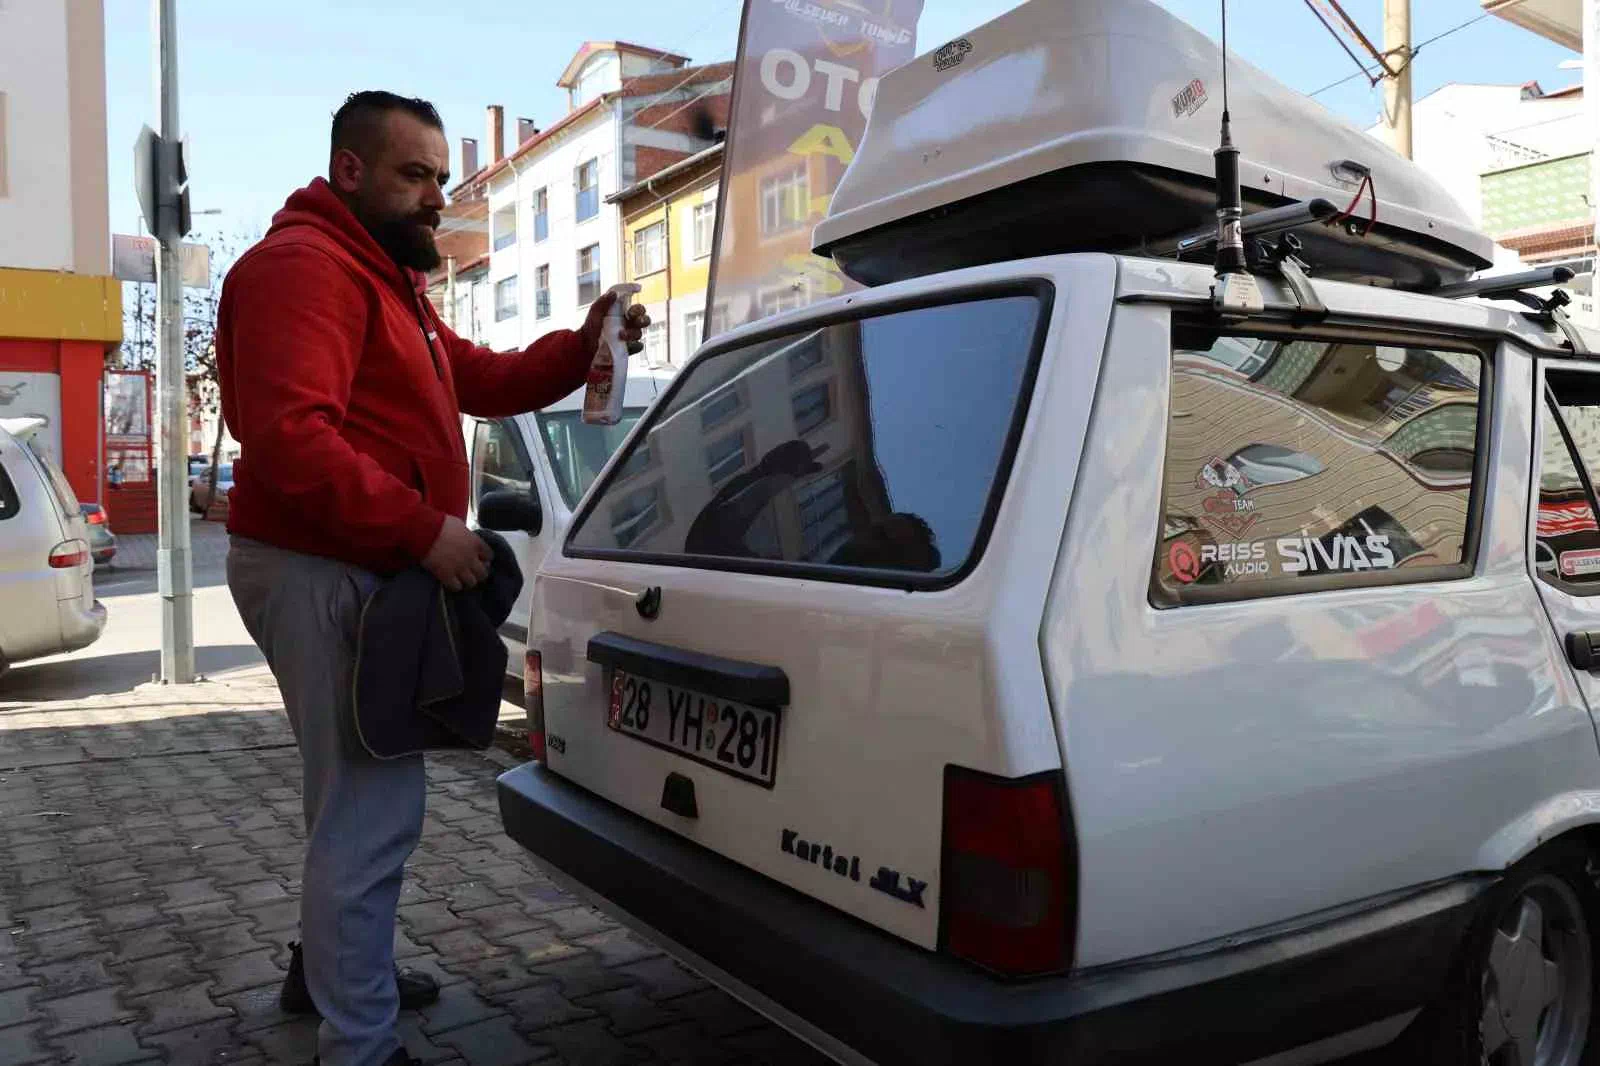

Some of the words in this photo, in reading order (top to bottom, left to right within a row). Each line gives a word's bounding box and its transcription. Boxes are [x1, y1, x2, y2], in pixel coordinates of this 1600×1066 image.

[1201, 542, 1266, 563] REISS
[1224, 561, 1270, 577] AUDIO
[622, 677, 651, 731] 28
[667, 687, 705, 752] YH
[717, 705, 773, 776] 281
[781, 828, 860, 883] Kartal
